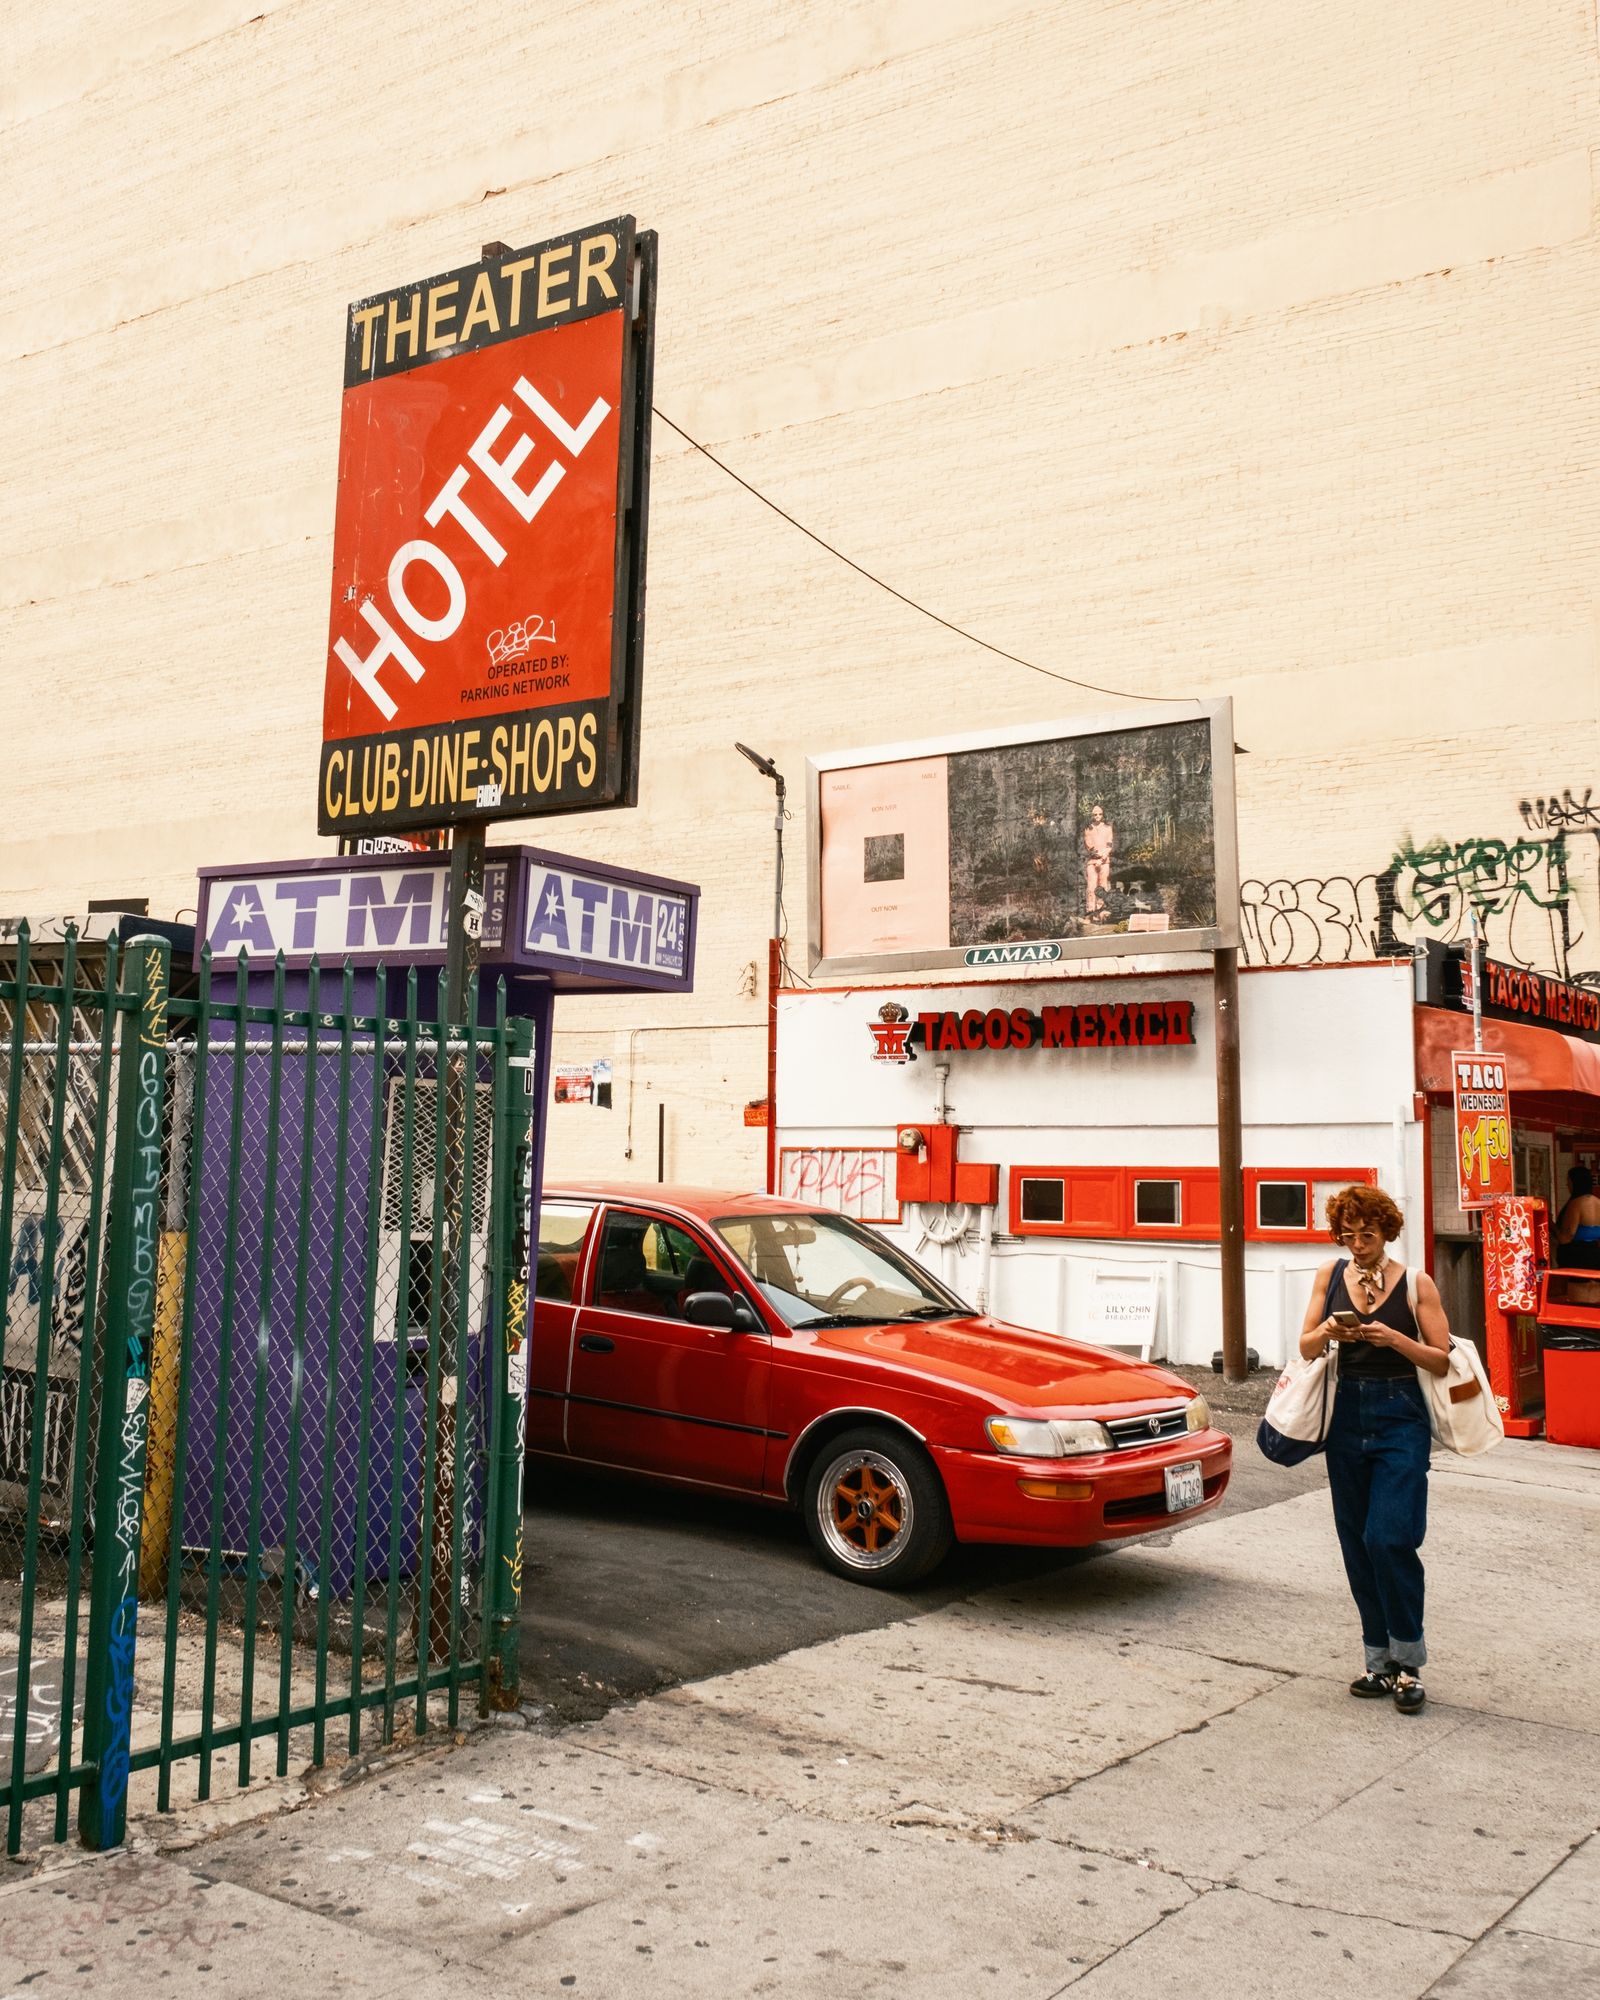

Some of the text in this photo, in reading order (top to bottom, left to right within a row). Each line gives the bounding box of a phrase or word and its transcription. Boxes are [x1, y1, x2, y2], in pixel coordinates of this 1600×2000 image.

[354, 233, 619, 371] THEATER
[333, 375, 612, 722] HOTEL
[487, 654, 570, 680] OPERATED BY:
[460, 673, 571, 703] PARKING NETWORK
[207, 872, 435, 952] ATM
[527, 872, 652, 964] ATM
[656, 903, 678, 950] 24
[870, 905, 883, 913] OUT
[972, 945, 1053, 964] LAMAR
[1485, 961, 1541, 1016] TACOS
[1545, 979, 1600, 1032] MEXICO
[918, 1001, 1196, 1051] TACOS MEXICO
[1457, 1064, 1505, 1090] TACO
[1459, 1094, 1506, 1111] WEDNESDAY
[1106, 1305, 1151, 1314] LILY CHIN
